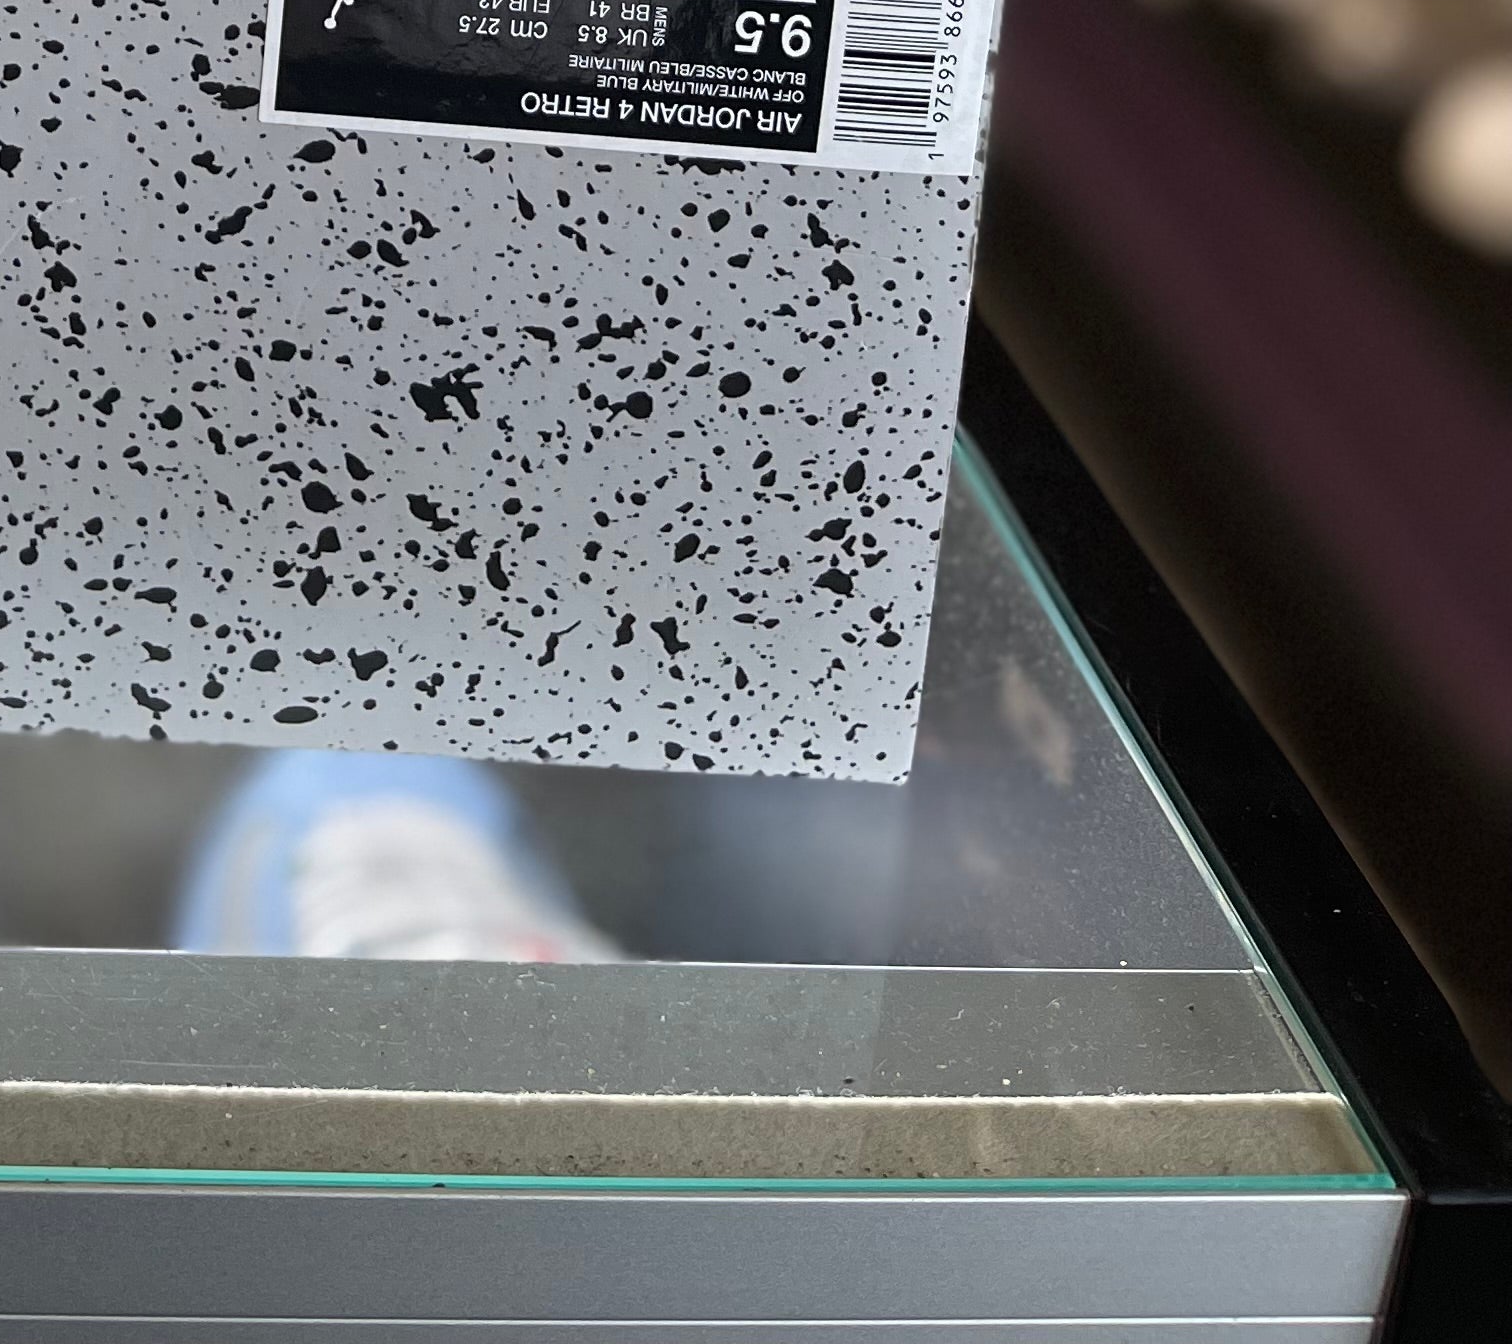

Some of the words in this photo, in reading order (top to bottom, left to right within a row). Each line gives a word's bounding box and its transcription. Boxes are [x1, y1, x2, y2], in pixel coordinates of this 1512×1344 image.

[589, 0, 611, 18] 41
[621, 2, 650, 22] BR
[459, 15, 501, 36] 27.5
[510, 19, 548, 39] cm
[578, 24, 608, 44] 8.5
[651, 6, 669, 47] MENS
[734, 10, 813, 58] 9.5
[617, 27, 648, 47] UK
[568, 54, 645, 73] MILITAIRE
[648, 60, 749, 82] CASSE/BLEU
[597, 75, 638, 91] BLUE
[752, 68, 807, 86] BLANC
[642, 78, 769, 102] WHITE/MILITARY
[772, 90, 805, 104] OFF
[932, 53, 958, 123] 97593
[520, 91, 610, 120] RETRO
[618, 99, 634, 119] 4
[640, 100, 751, 130] JORDAN
[756, 111, 803, 134] AIR
